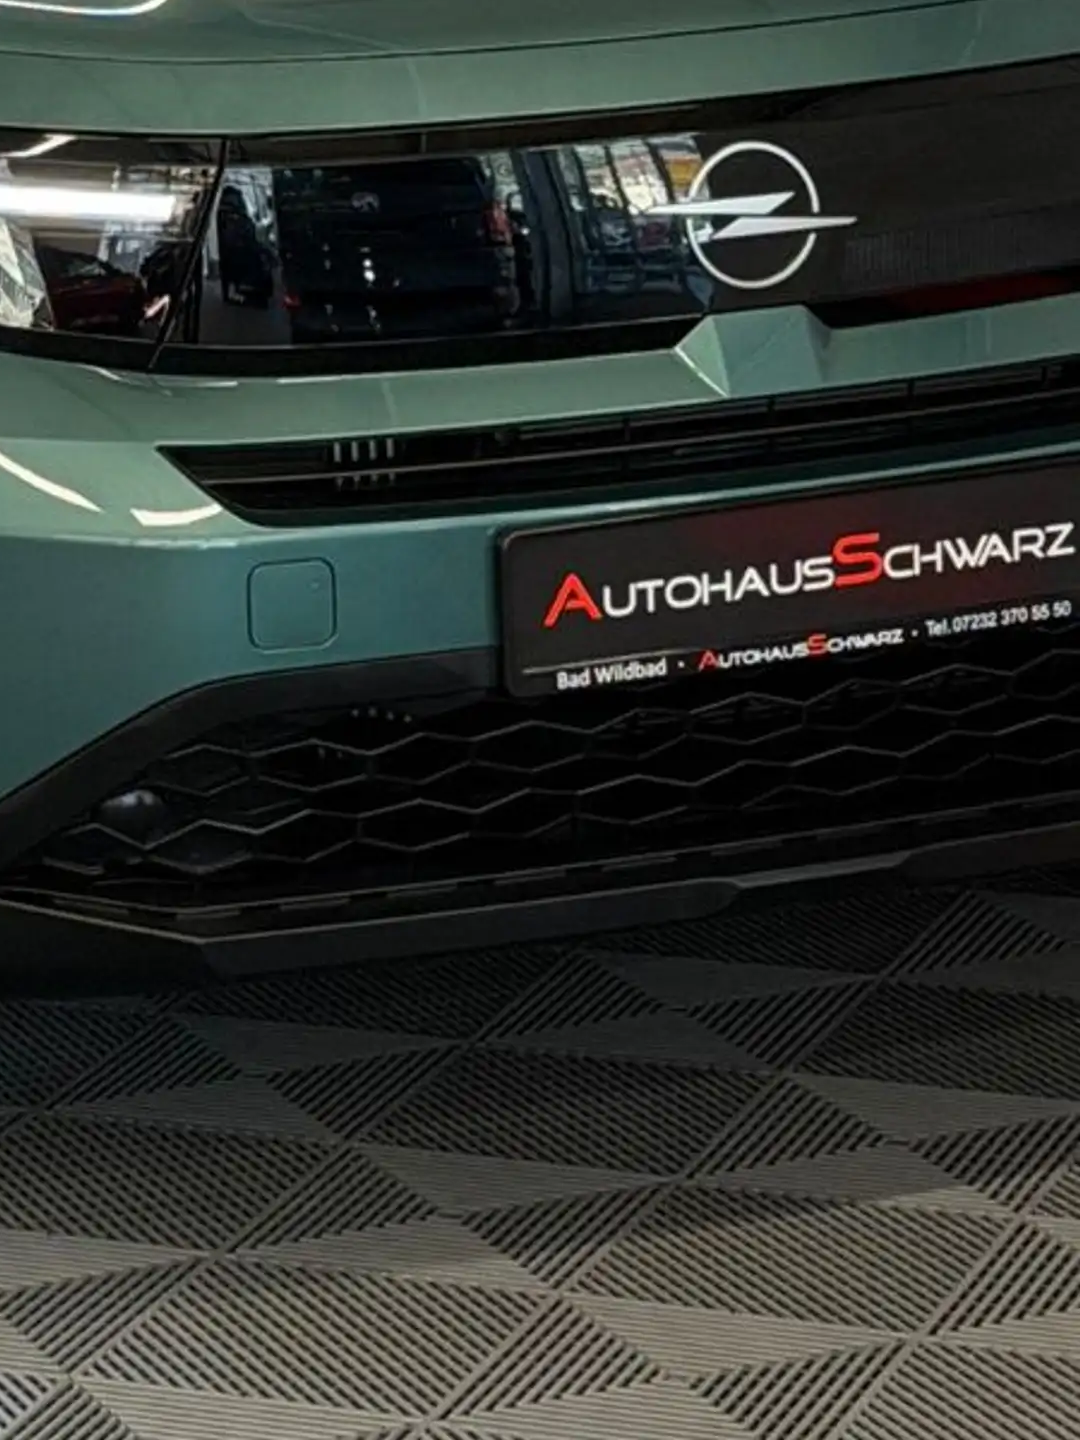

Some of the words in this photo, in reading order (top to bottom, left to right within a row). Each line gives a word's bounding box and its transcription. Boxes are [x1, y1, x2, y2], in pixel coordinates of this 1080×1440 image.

[556, 668, 590, 690] Bad
[594, 658, 668, 684] Wildbad
[1001, 607, 1028, 626] 370
[1053, 600, 1073, 618] 50
